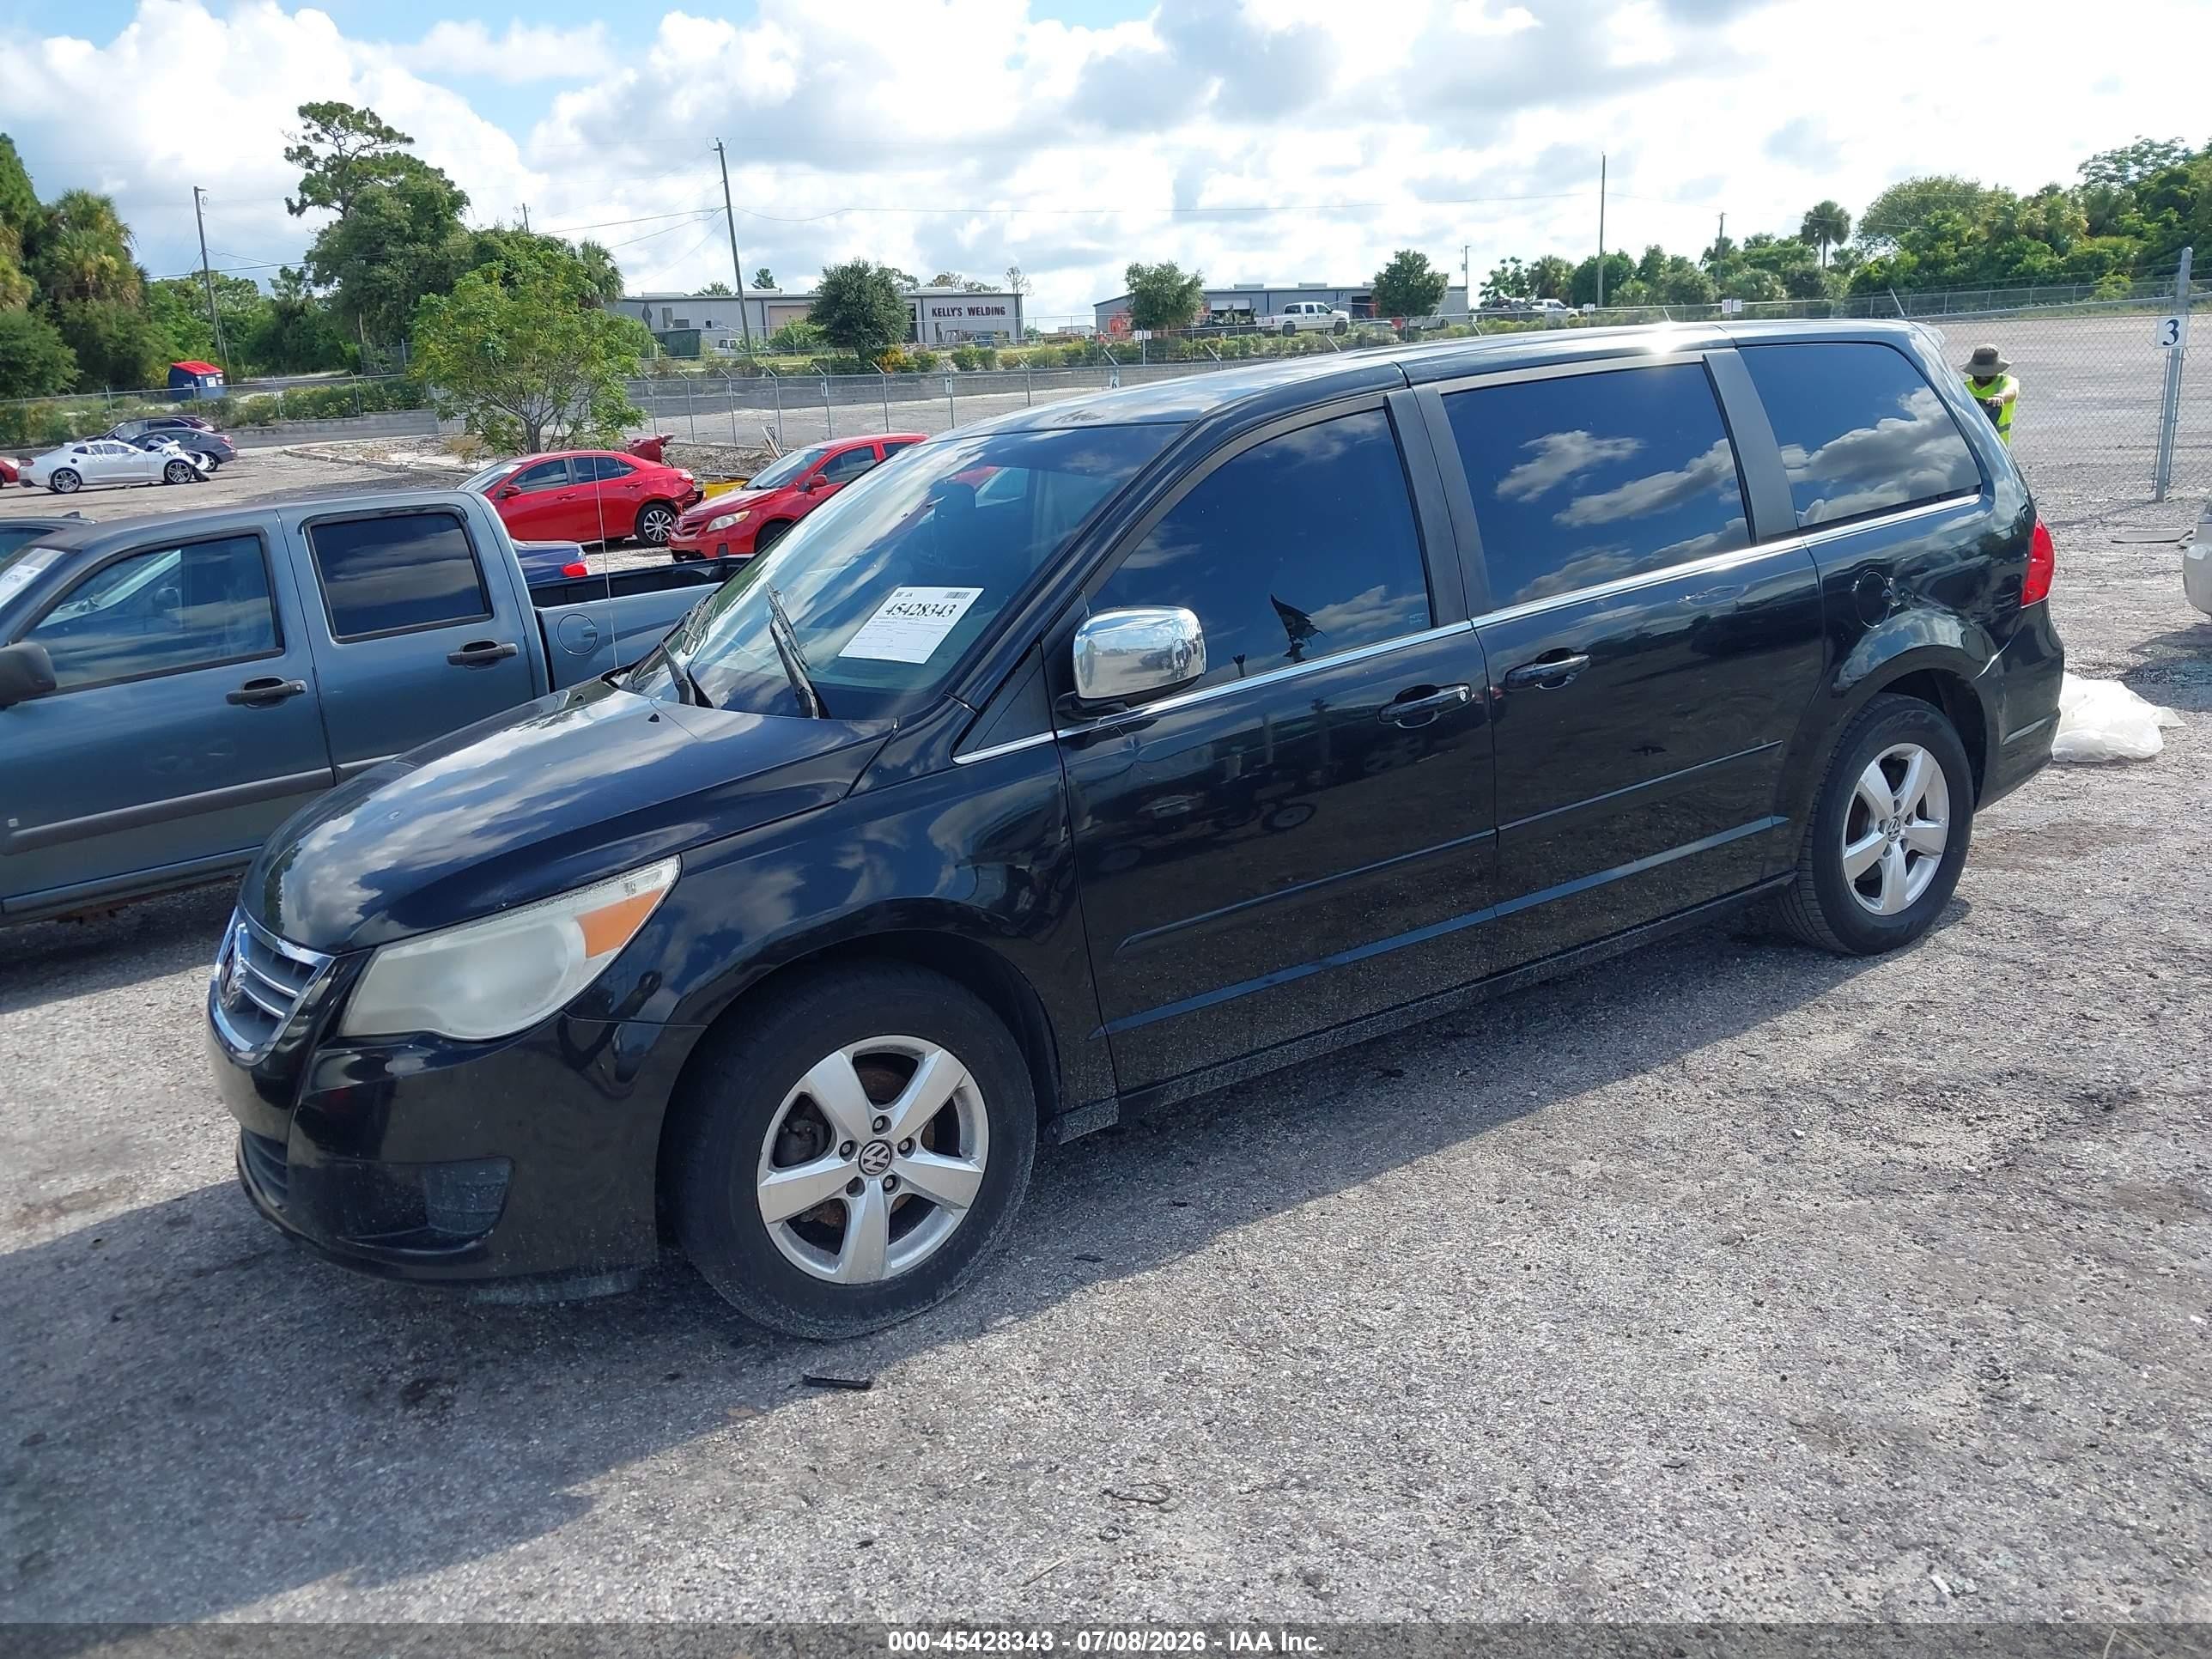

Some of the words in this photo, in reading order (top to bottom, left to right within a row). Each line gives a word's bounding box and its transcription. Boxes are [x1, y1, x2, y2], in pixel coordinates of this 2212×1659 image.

[932, 307, 963, 318] KELLY'S
[968, 306, 1006, 317] WELDING
[2162, 319, 2179, 346] 3
[885, 603, 957, 617] 45428343
